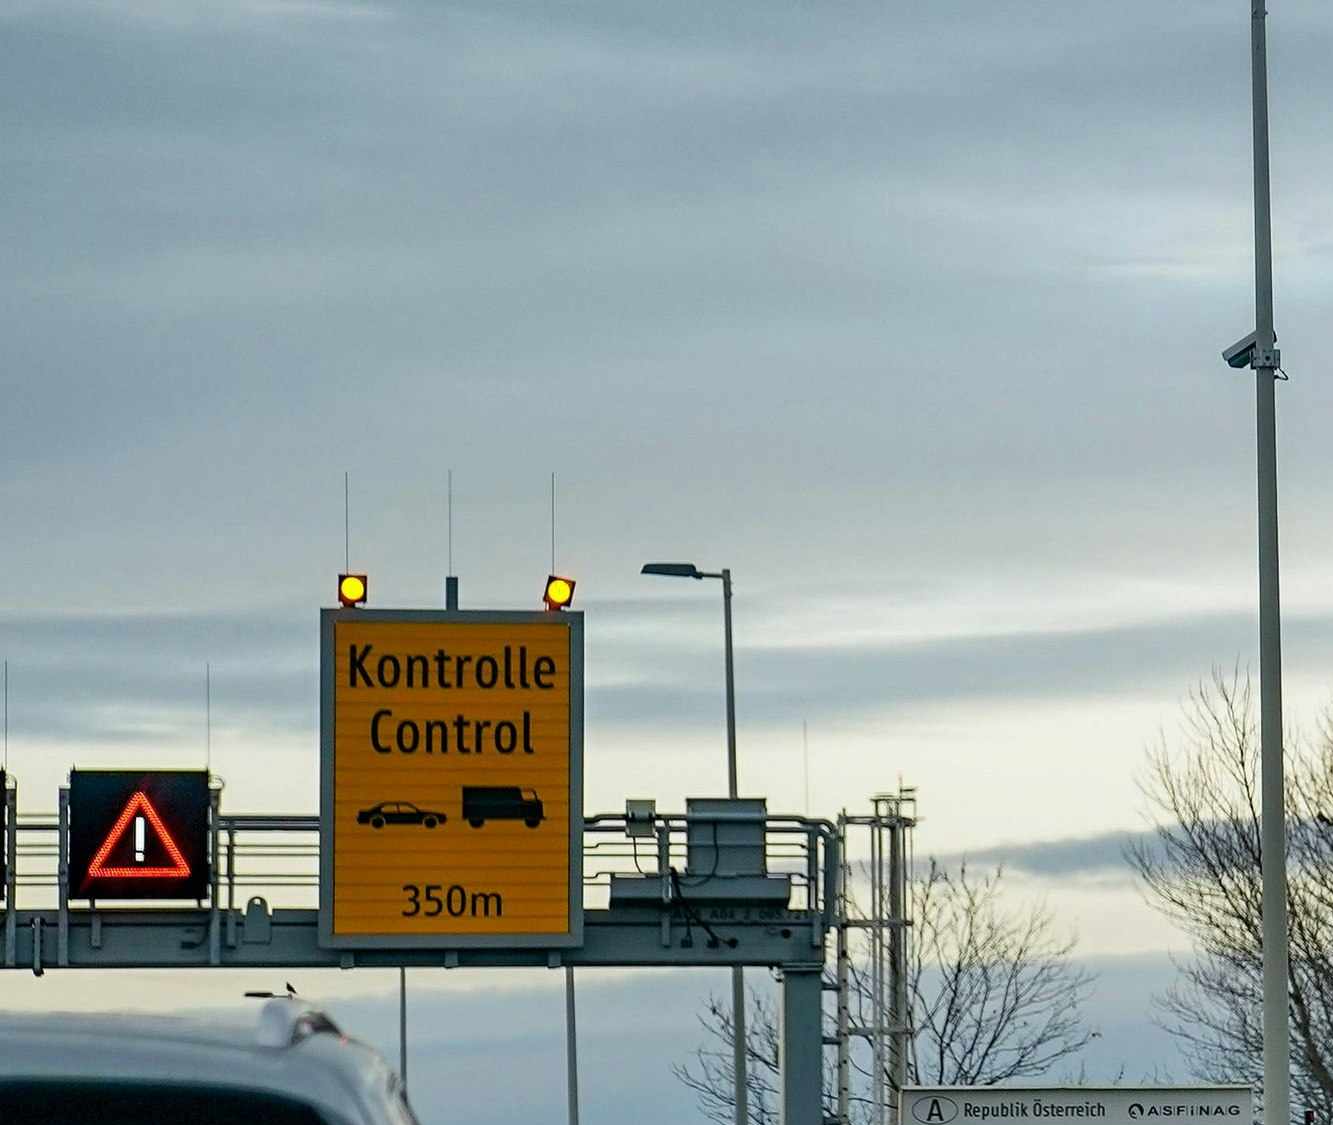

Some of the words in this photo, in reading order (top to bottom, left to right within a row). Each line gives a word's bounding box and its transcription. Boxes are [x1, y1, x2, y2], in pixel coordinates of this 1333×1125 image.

[349, 644, 556, 689] Kontrolle
[371, 709, 535, 754] Control
[402, 884, 503, 917] 350m
[927, 1099, 944, 1121] A
[964, 1101, 1028, 1120] Republik
[1033, 1098, 1105, 1118] Österreich
